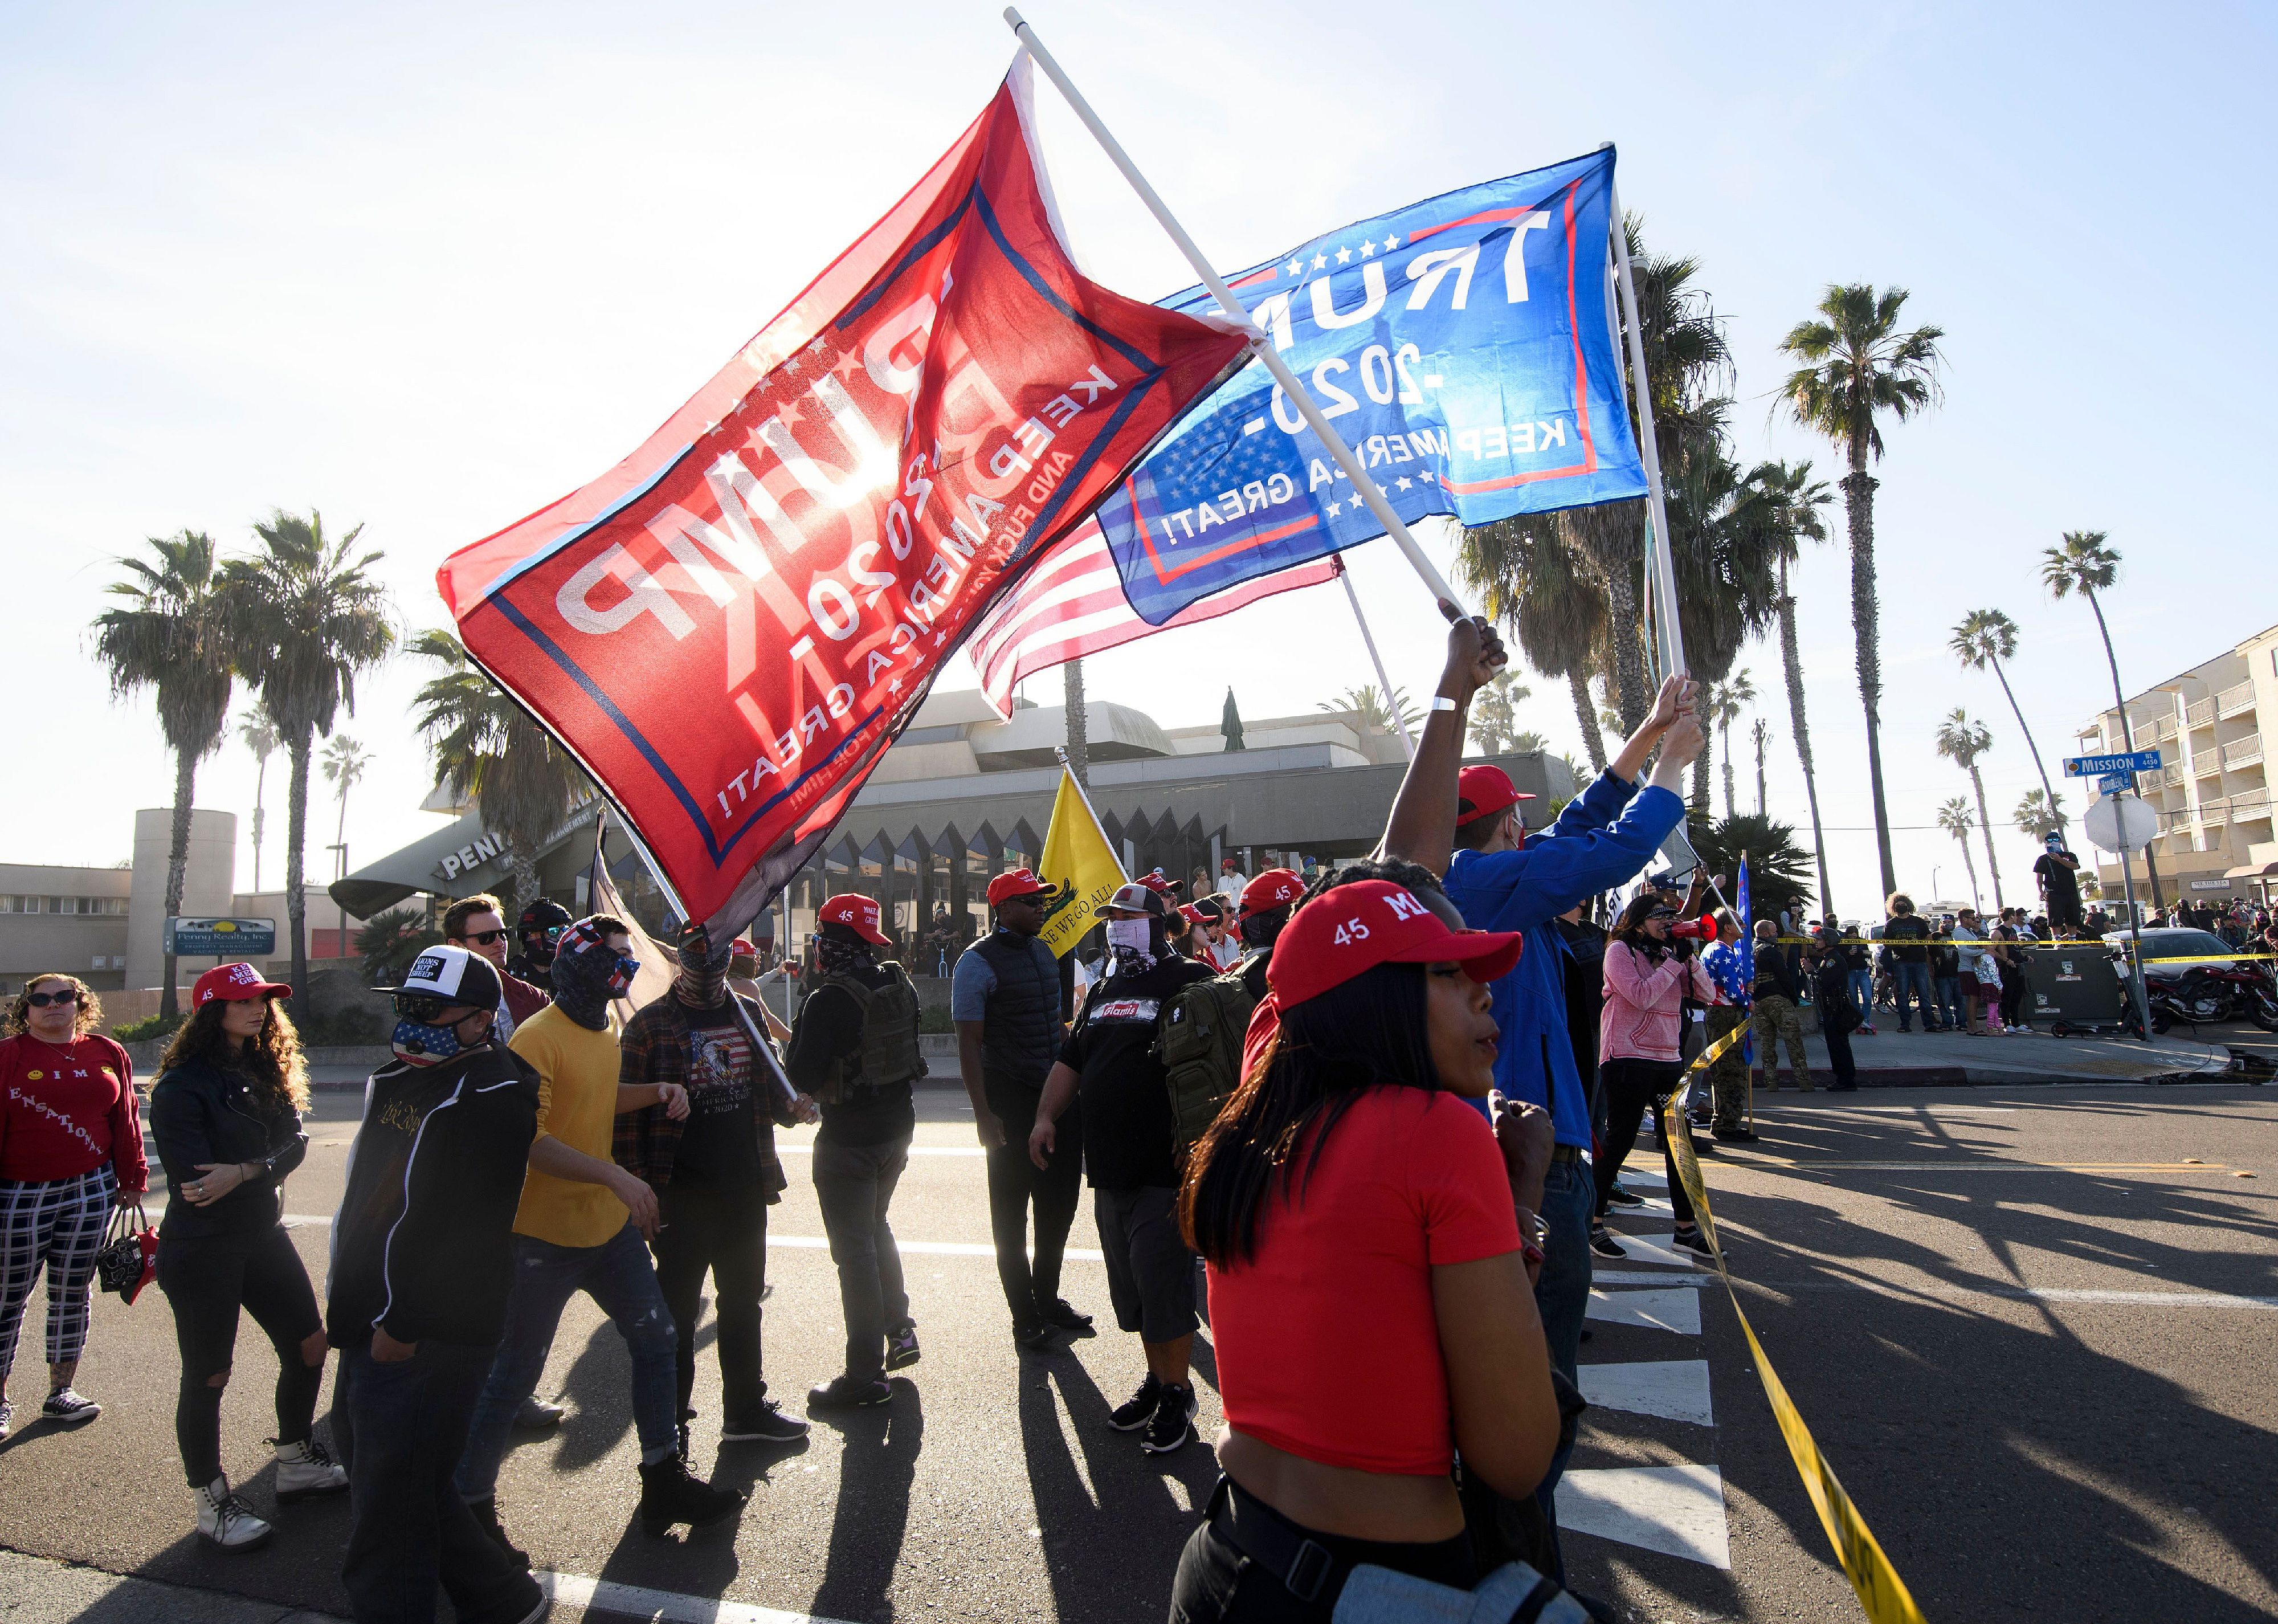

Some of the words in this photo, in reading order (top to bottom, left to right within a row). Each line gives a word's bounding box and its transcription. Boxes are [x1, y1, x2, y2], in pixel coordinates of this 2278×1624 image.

[2081, 758, 2134, 773] MISSION
[1276, 885, 1291, 900] 45
[838, 910, 854, 921] 45
[1055, 913, 1076, 935] WE
[1075, 900, 1090, 919] GO
[1334, 917, 1370, 945] 45
[202, 988, 213, 1001] 45
[53, 1071, 61, 1079] I
[73, 1069, 89, 1078] M
[10, 1086, 104, 1155] ENSATIONAL
